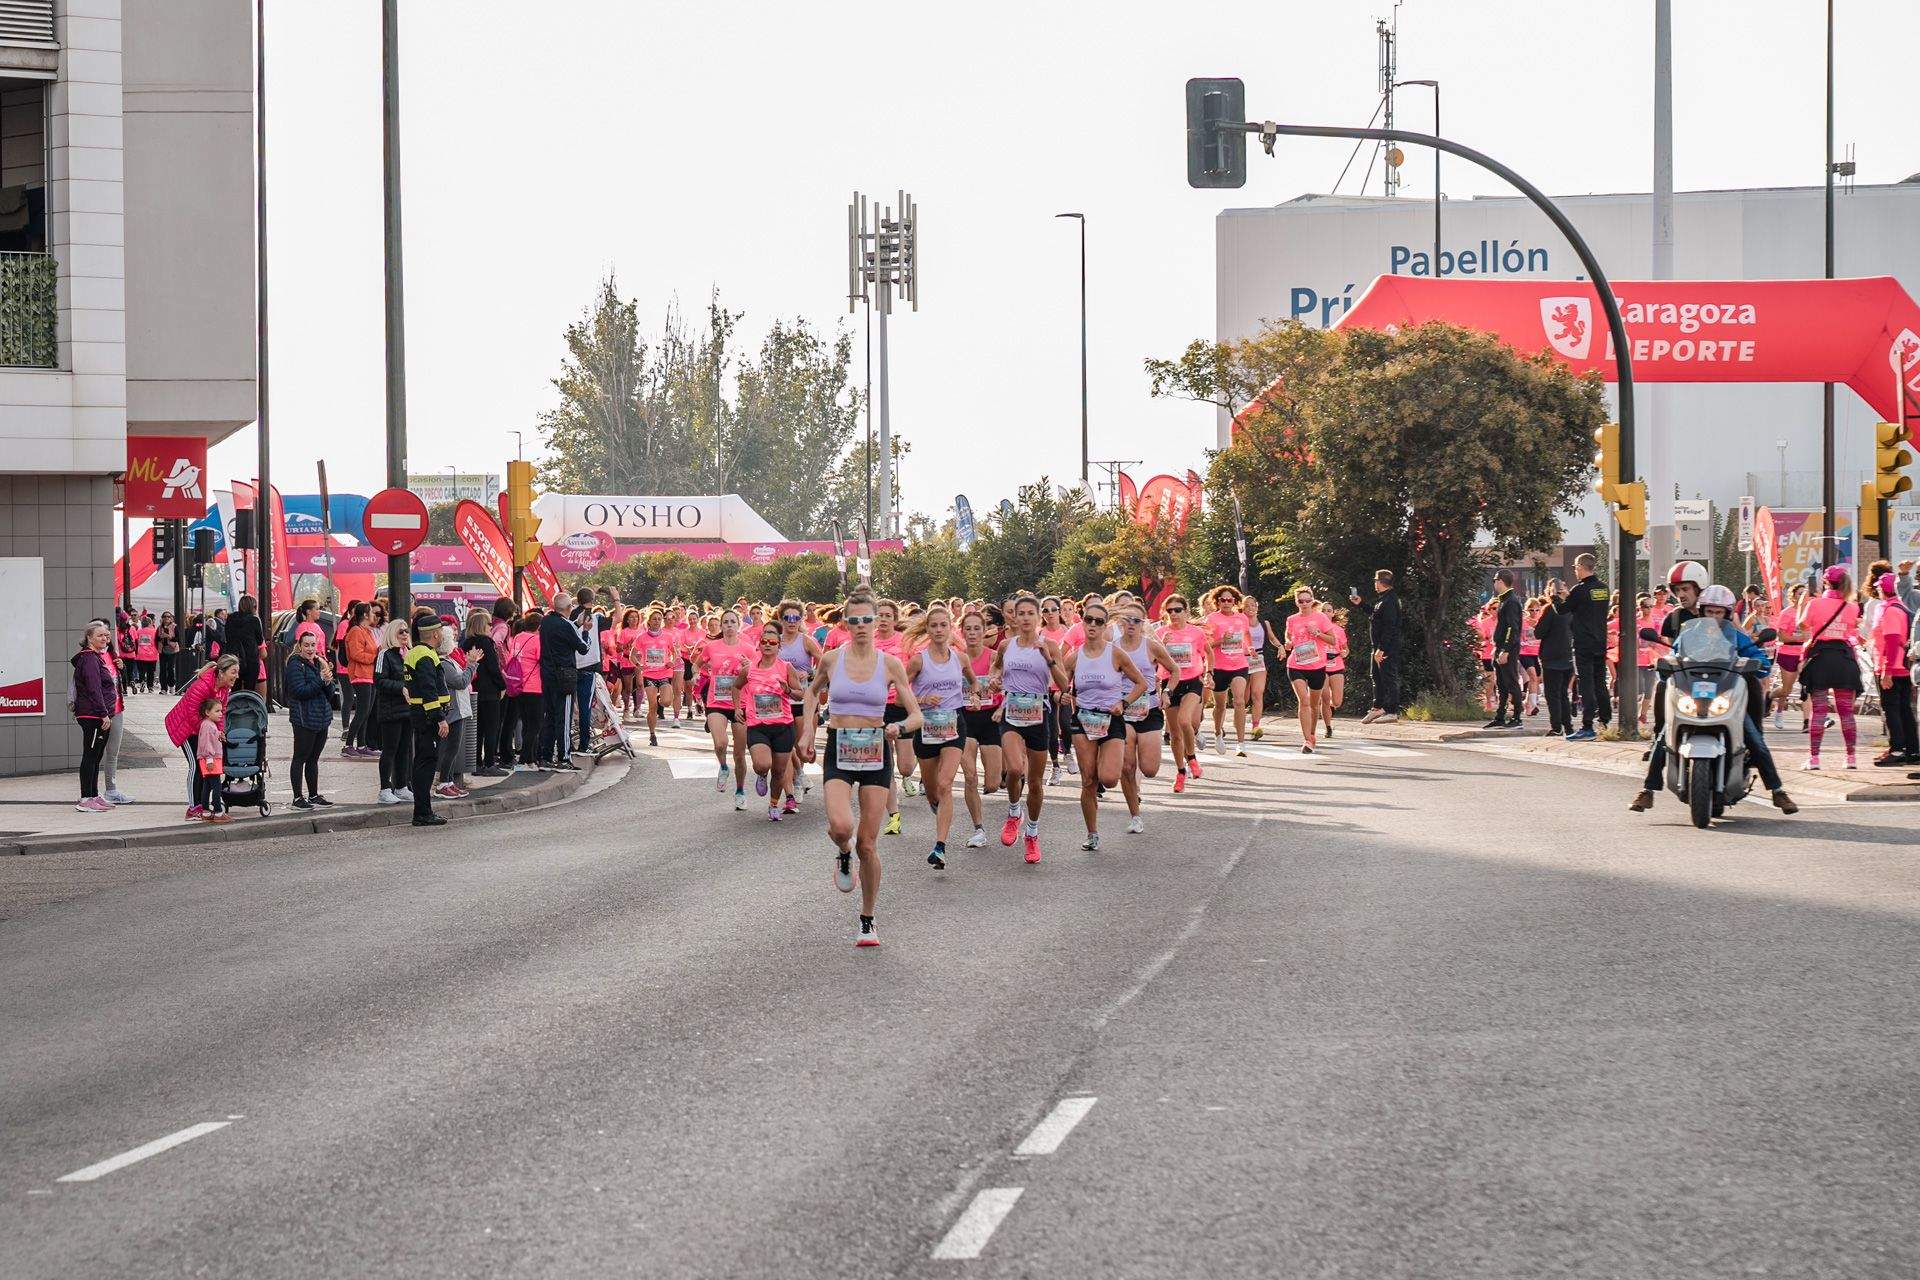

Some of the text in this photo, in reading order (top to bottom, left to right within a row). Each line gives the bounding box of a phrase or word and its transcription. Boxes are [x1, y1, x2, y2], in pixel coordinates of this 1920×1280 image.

[1390, 239, 1549, 277] Pabellón
[128, 457, 165, 482] Mi
[583, 502, 702, 529] OYSHO
